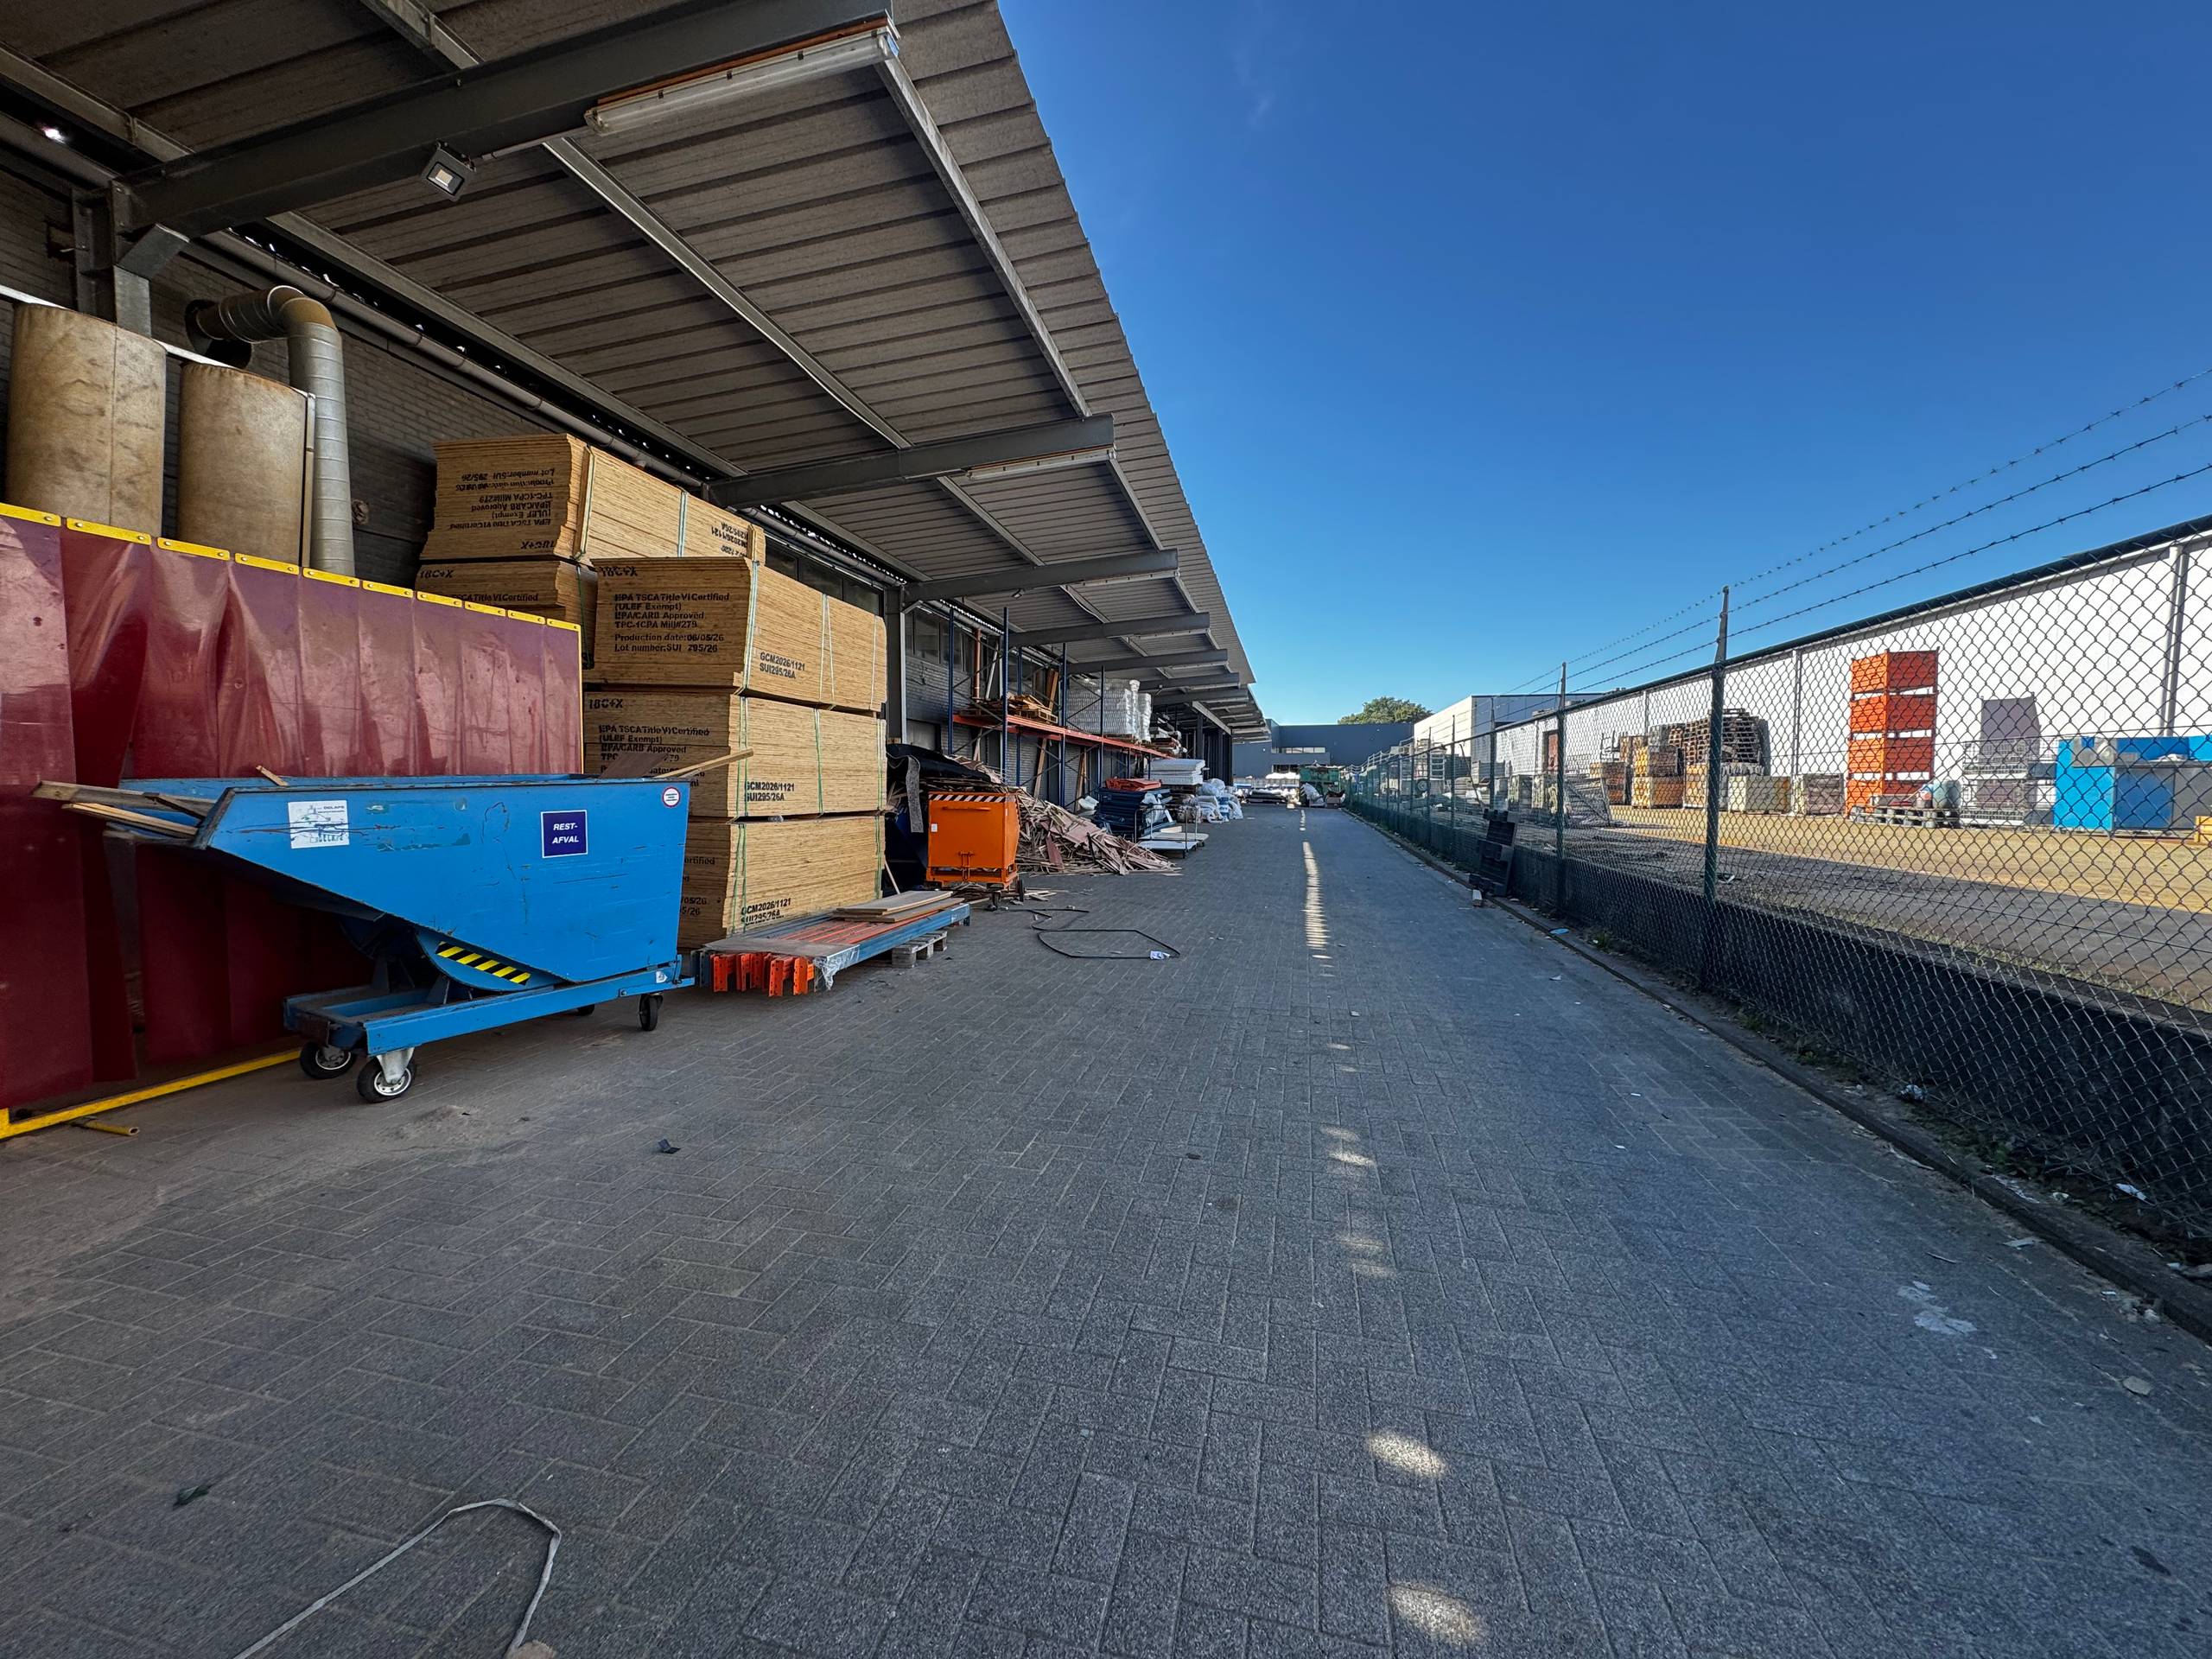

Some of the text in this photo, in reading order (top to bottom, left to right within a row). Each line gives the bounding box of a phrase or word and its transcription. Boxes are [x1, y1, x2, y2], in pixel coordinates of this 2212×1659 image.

[614, 603, 682, 612] (ULEF Exempt)
[663, 612, 704, 620] Approved
[647, 745, 687, 753] Approved
[552, 836, 579, 844] AFVAL
[684, 856, 715, 865] ertified
